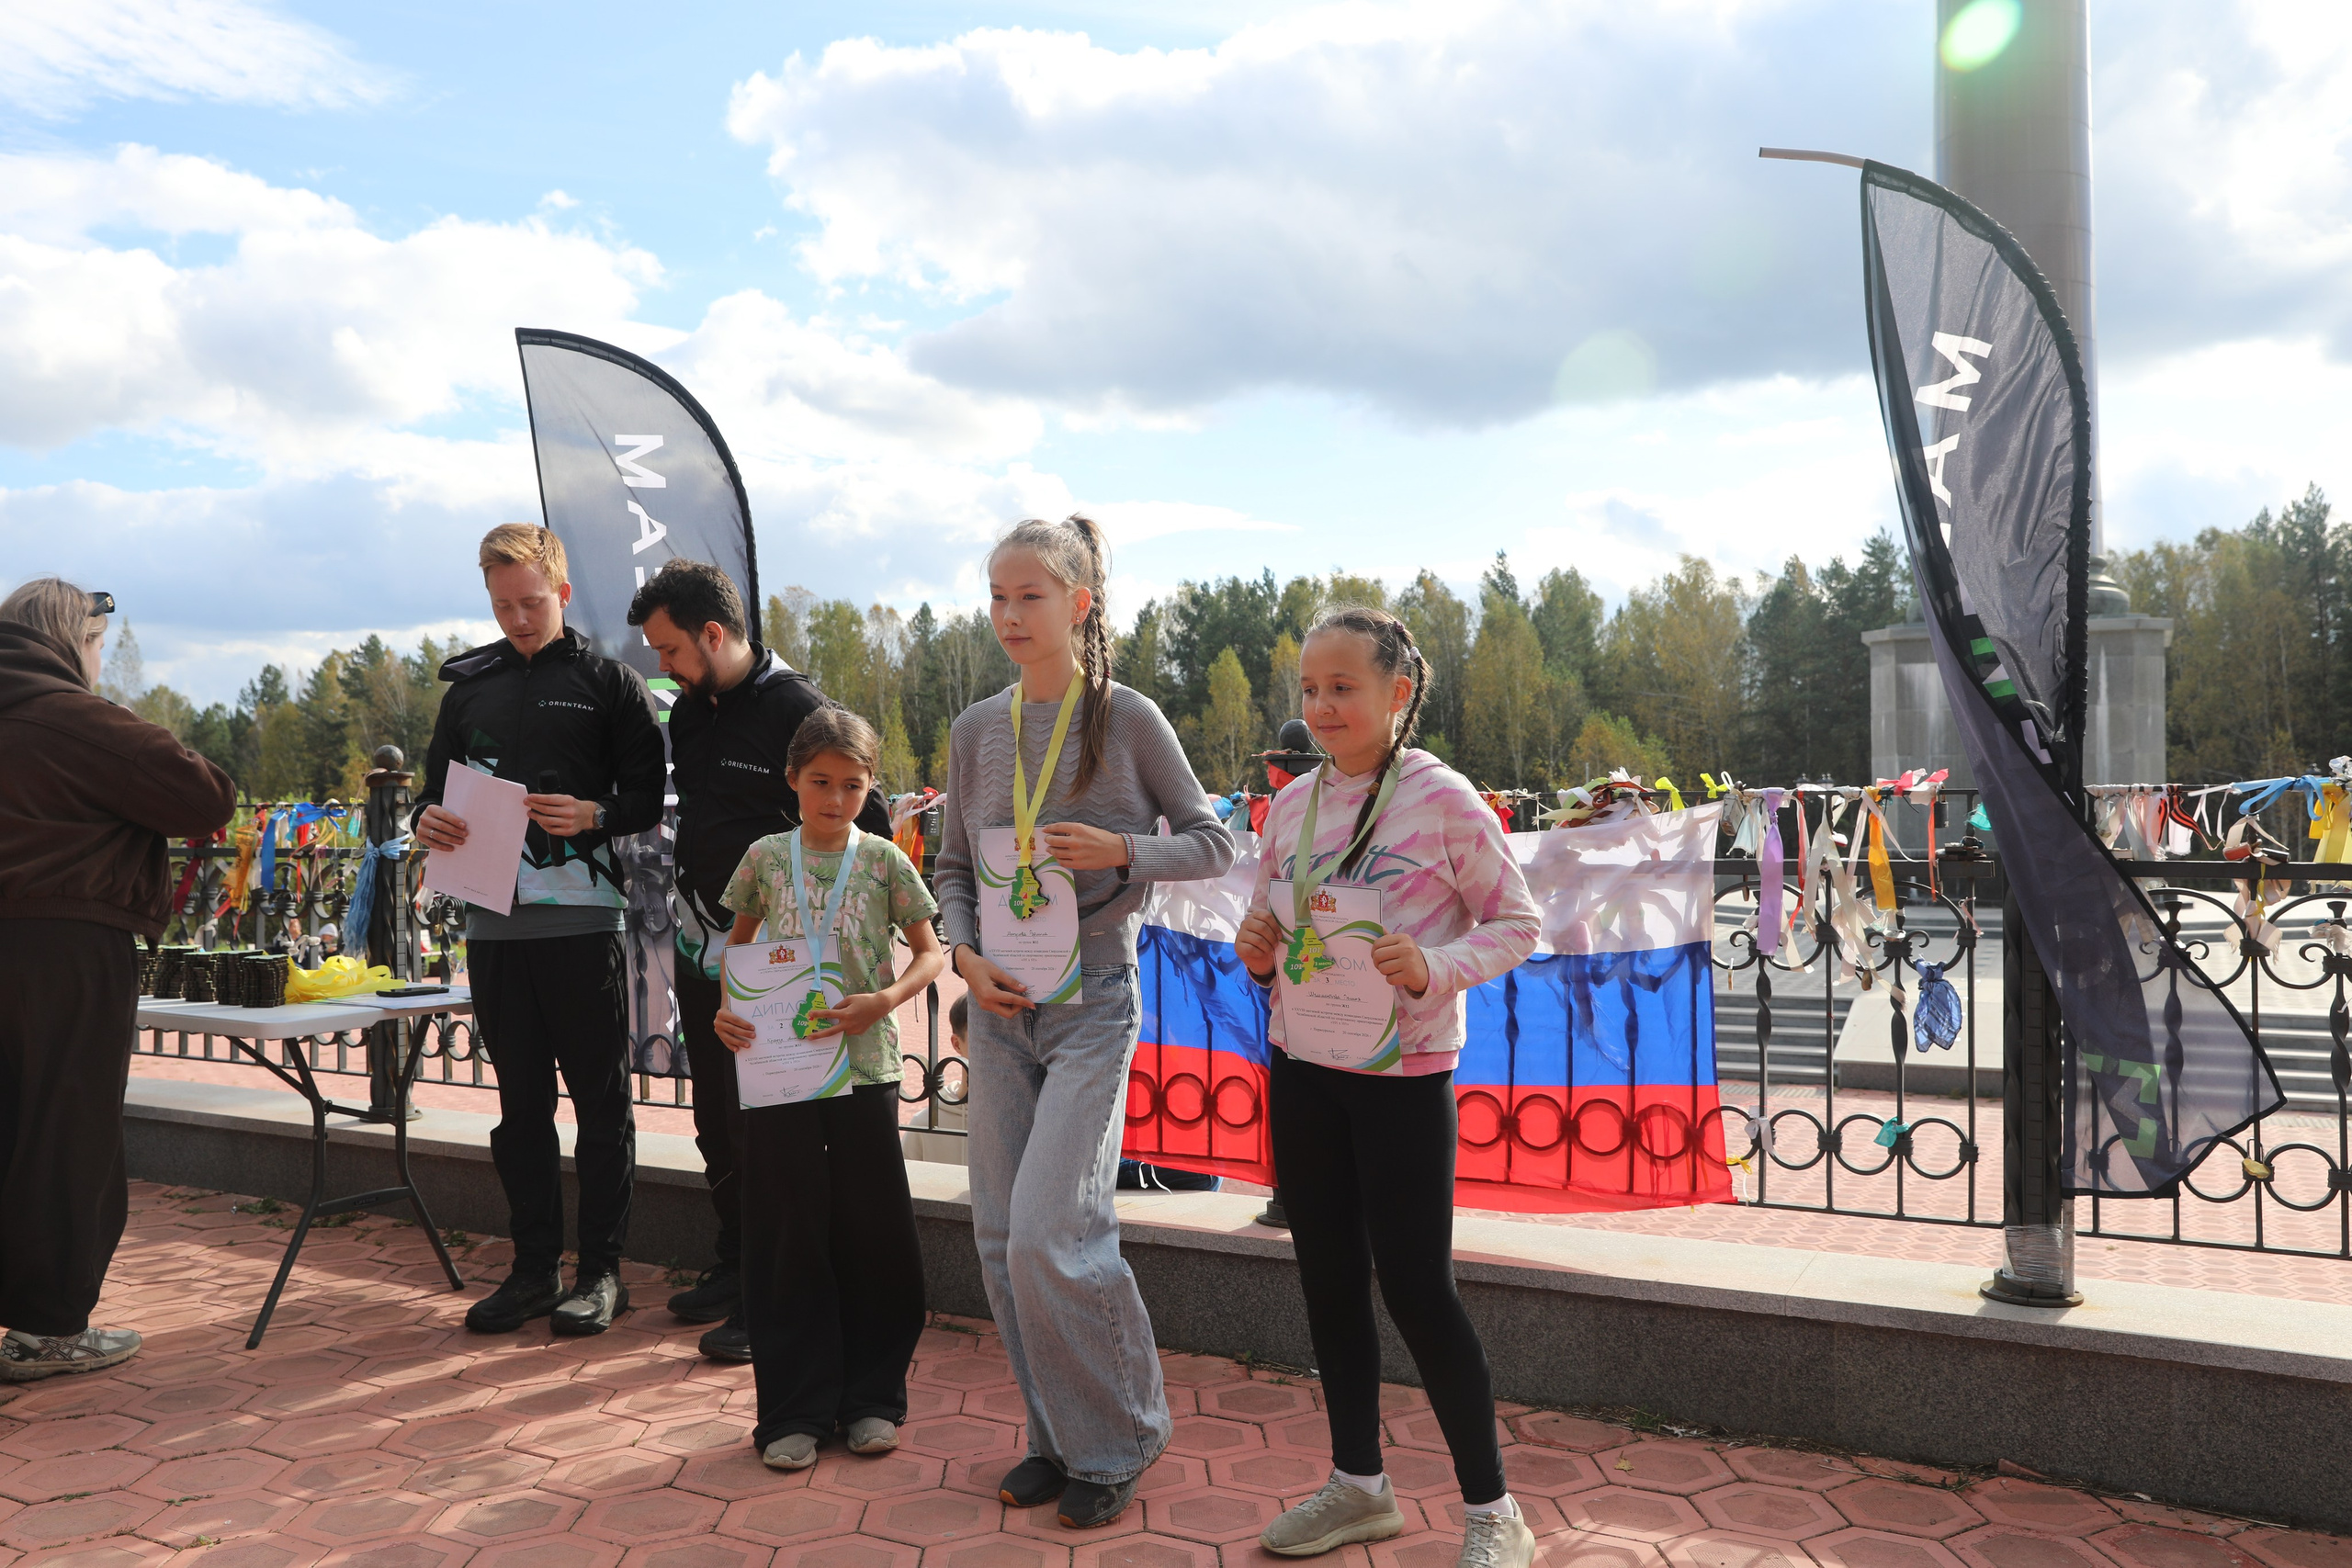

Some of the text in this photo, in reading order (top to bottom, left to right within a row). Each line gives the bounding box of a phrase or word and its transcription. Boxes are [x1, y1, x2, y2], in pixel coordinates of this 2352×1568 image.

[548, 701, 594, 711] ORIENTEAM
[728, 761, 770, 774] ORIENTEAM
[1335, 979, 1355, 987] МЕСТО
[752, 999, 808, 1019] ДИПЛО
